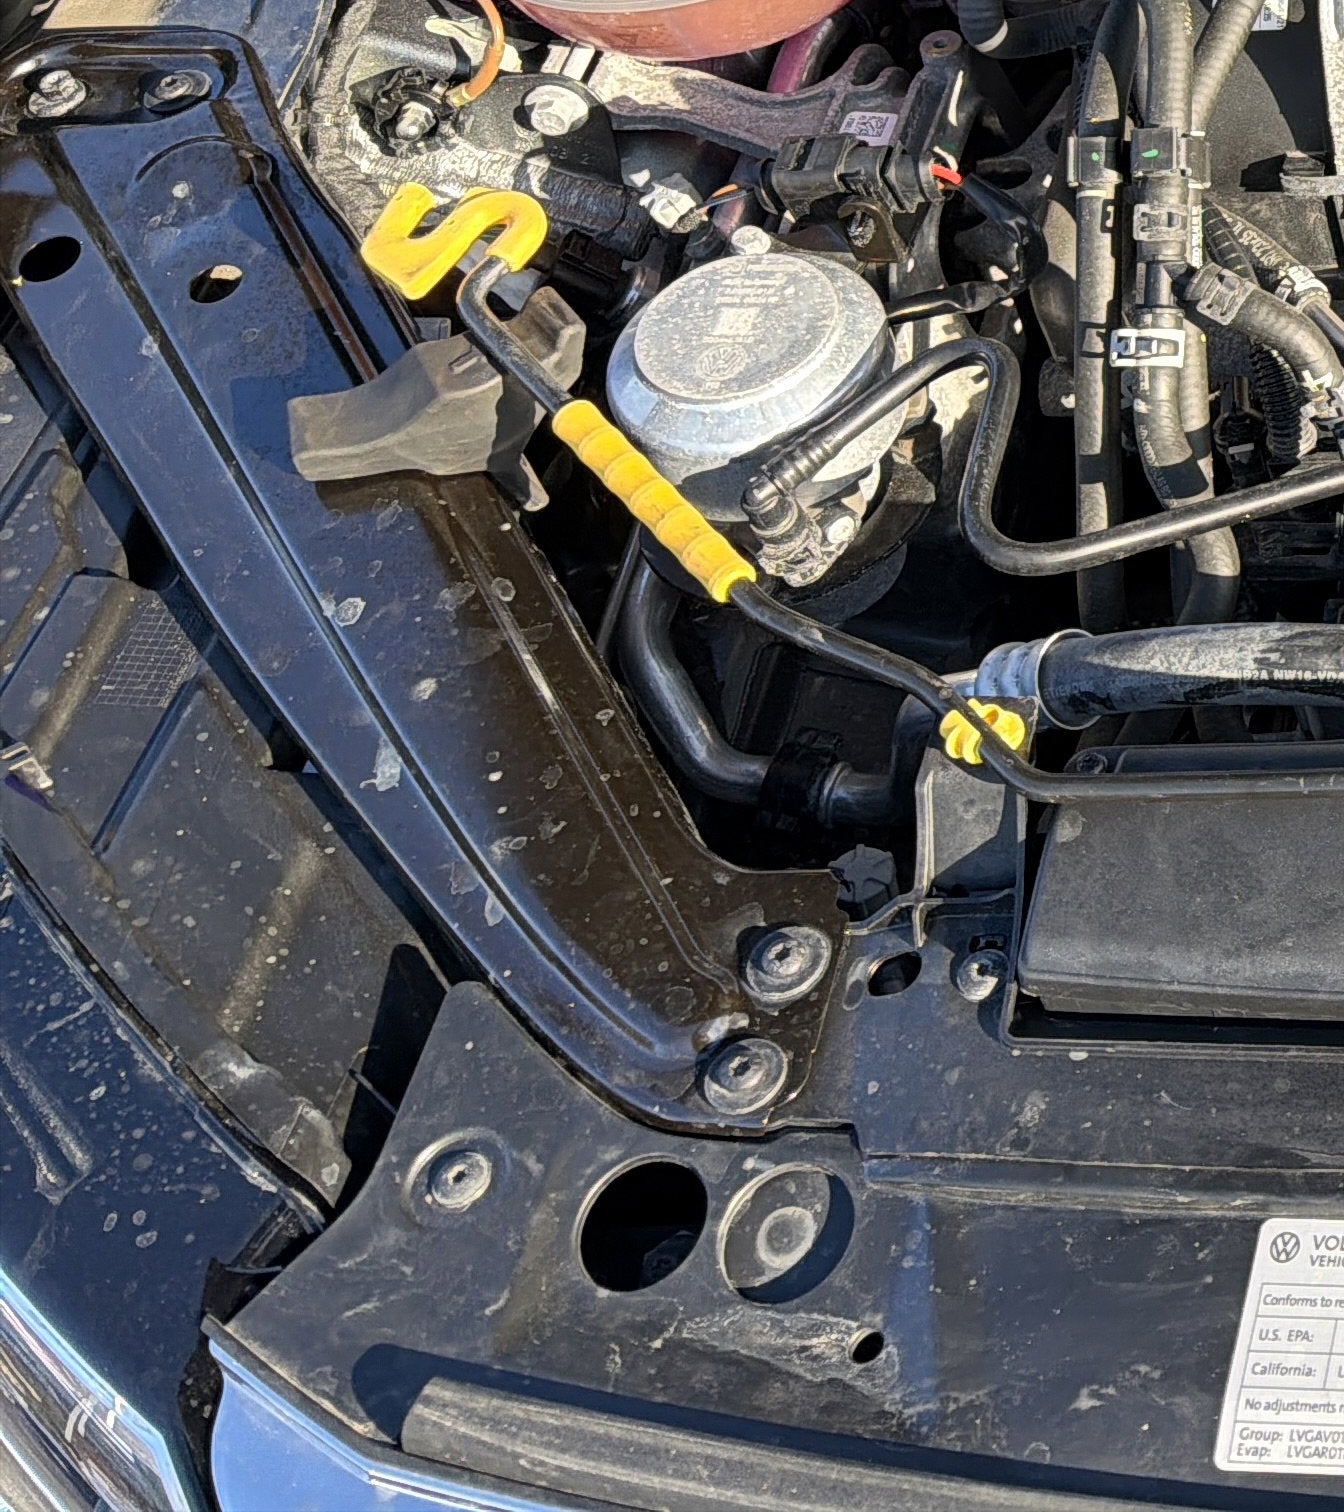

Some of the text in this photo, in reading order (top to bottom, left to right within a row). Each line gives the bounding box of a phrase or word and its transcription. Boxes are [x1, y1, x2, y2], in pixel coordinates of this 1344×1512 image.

[1262, 1294, 1318, 1308] Conforms
[1320, 1296, 1332, 1308] to
[1258, 1329, 1314, 1343] U.S. EPA:
[1251, 1362, 1317, 1377] California:
[1244, 1399, 1262, 1411] No
[1263, 1399, 1336, 1415] adjustments
[1239, 1427, 1283, 1443] Group:
[1236, 1443, 1271, 1458] Evap:
